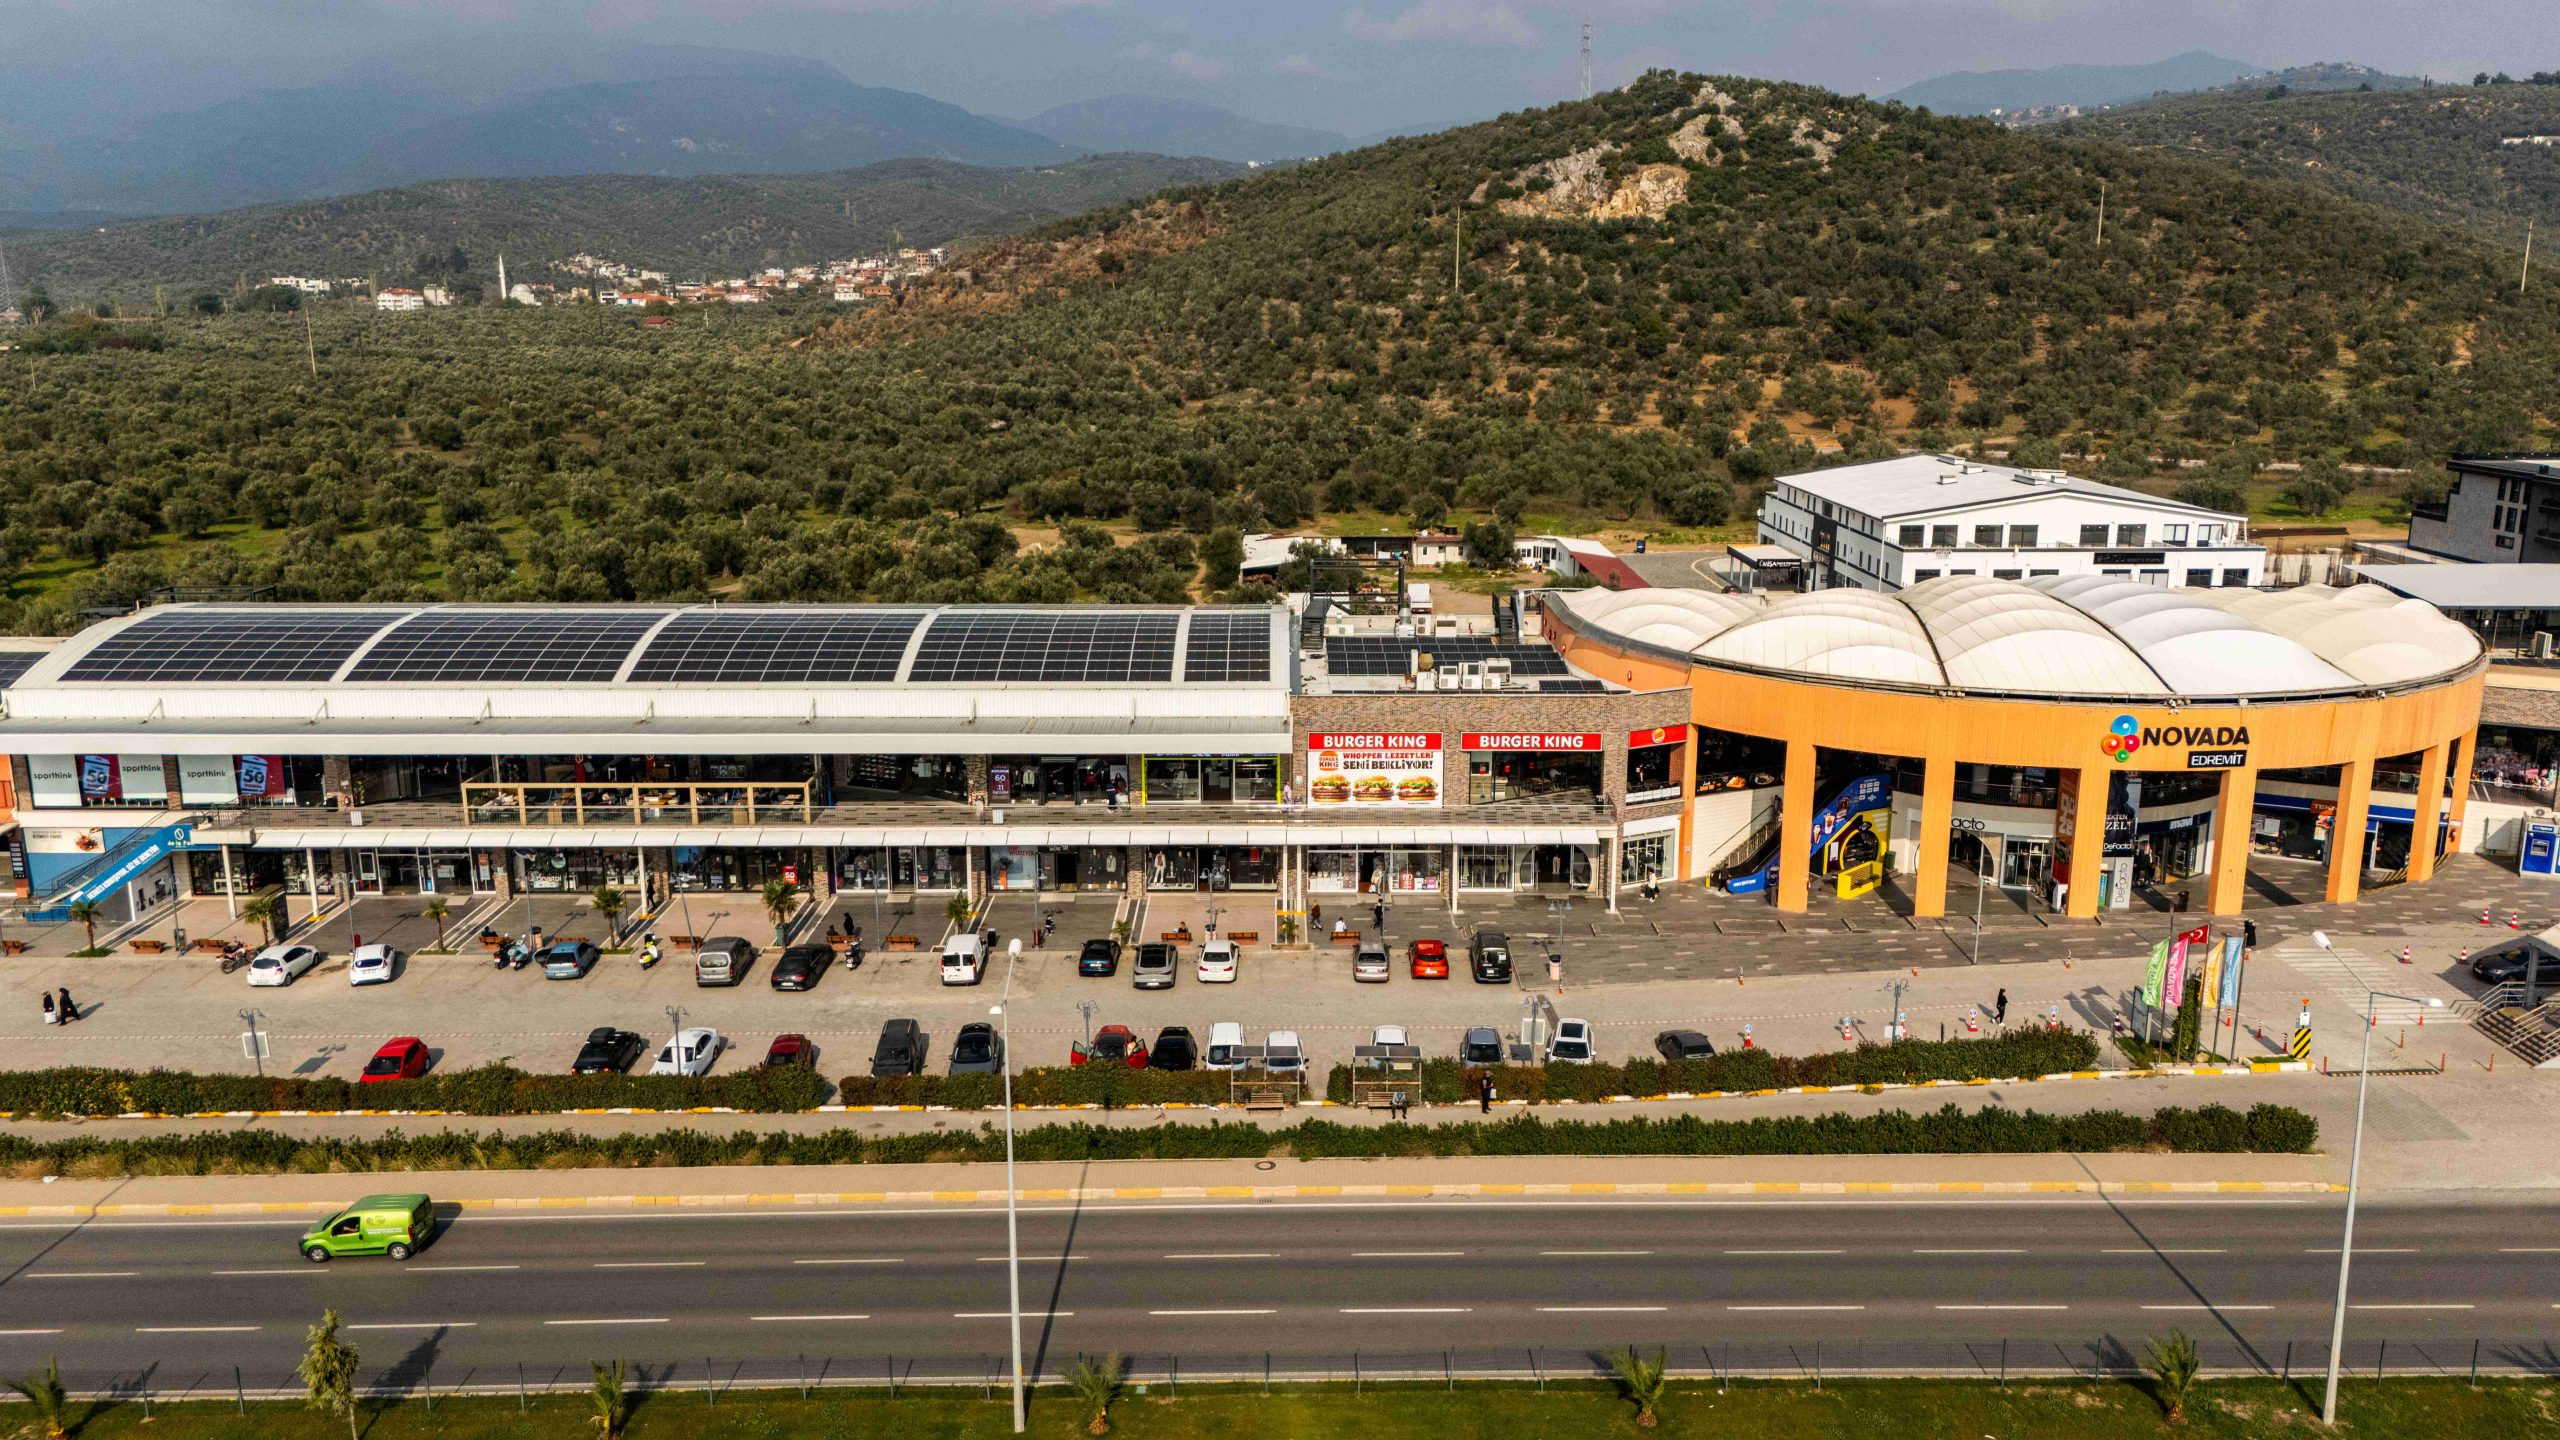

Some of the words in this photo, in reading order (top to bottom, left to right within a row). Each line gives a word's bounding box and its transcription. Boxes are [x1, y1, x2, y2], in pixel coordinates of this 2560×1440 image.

[1324, 736, 1384, 748] BURGER
[1388, 736, 1427, 748] KING
[1480, 736, 1535, 748] BURGER
[1544, 735, 1584, 748] KING
[2143, 726, 2250, 746] NOVADA
[1343, 760, 1370, 769] SENİ
[1371, 760, 1433, 769] BEKLİYOR!
[2191, 752, 2243, 766] EDREMİT
[122, 764, 161, 773] sporthink
[187, 769, 227, 778] sporthink
[34, 772, 72, 780] sporthink
[86, 768, 107, 784] 50
[243, 769, 265, 784] 50
[1951, 817, 1985, 830] acto
[2105, 821, 2127, 830] ZEL
[2103, 842, 2132, 850] DeFacto
[2114, 862, 2128, 903] DeFacto
